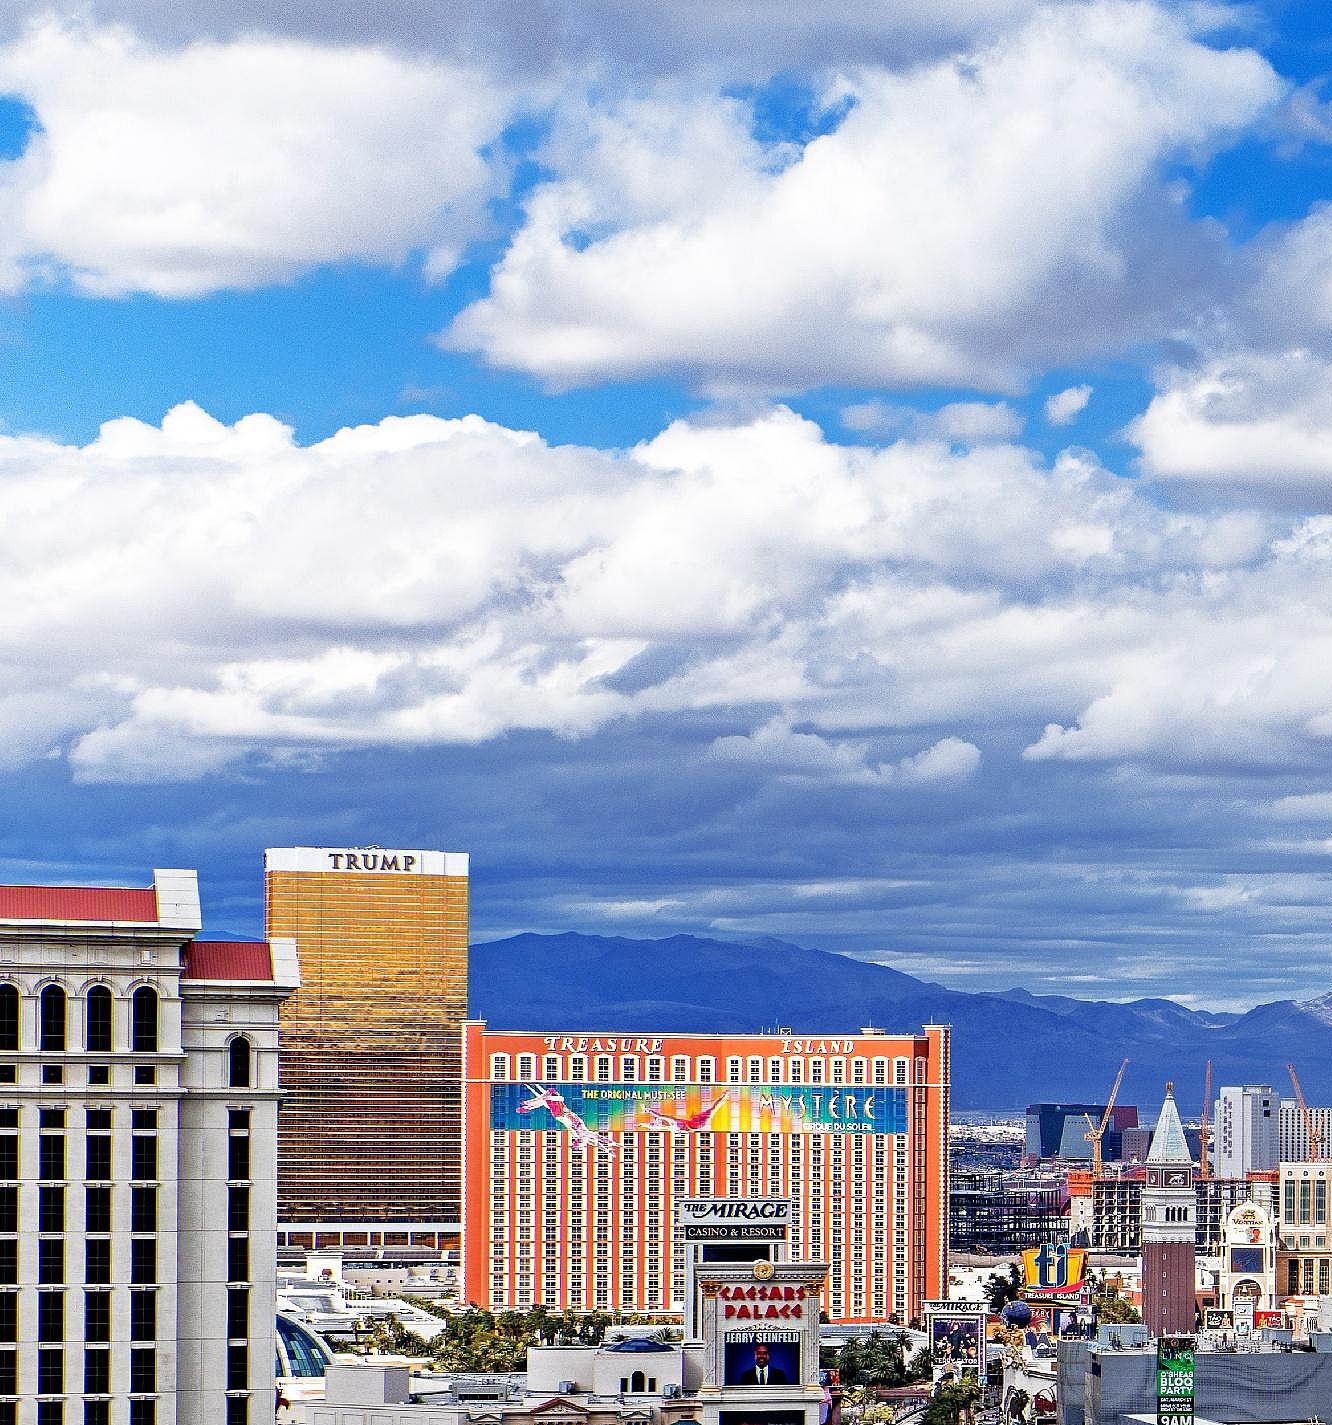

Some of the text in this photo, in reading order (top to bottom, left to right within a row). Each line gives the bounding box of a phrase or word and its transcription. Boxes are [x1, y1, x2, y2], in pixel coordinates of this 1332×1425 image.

[328, 853, 416, 871] TRUMP
[544, 1036, 854, 1054] TREASURE ISLAND
[582, 1089, 599, 1100] THE
[600, 1089, 642, 1100] ORIGINAL
[833, 1122, 845, 1130] DU
[704, 1202, 787, 1219] MIRAGE
[688, 1227, 784, 1237] CASINO & RESORT
[719, 1286, 806, 1302] CAESARS
[1024, 1292, 1080, 1300] TREASURE ISLAND
[725, 1304, 802, 1320] PALACE
[940, 1303, 984, 1312] MIRAGE
[725, 1332, 799, 1343] JERRY SEINFELD
[1160, 1378, 1193, 1387] BLOQ
[1160, 1387, 1193, 1395] PARTY
